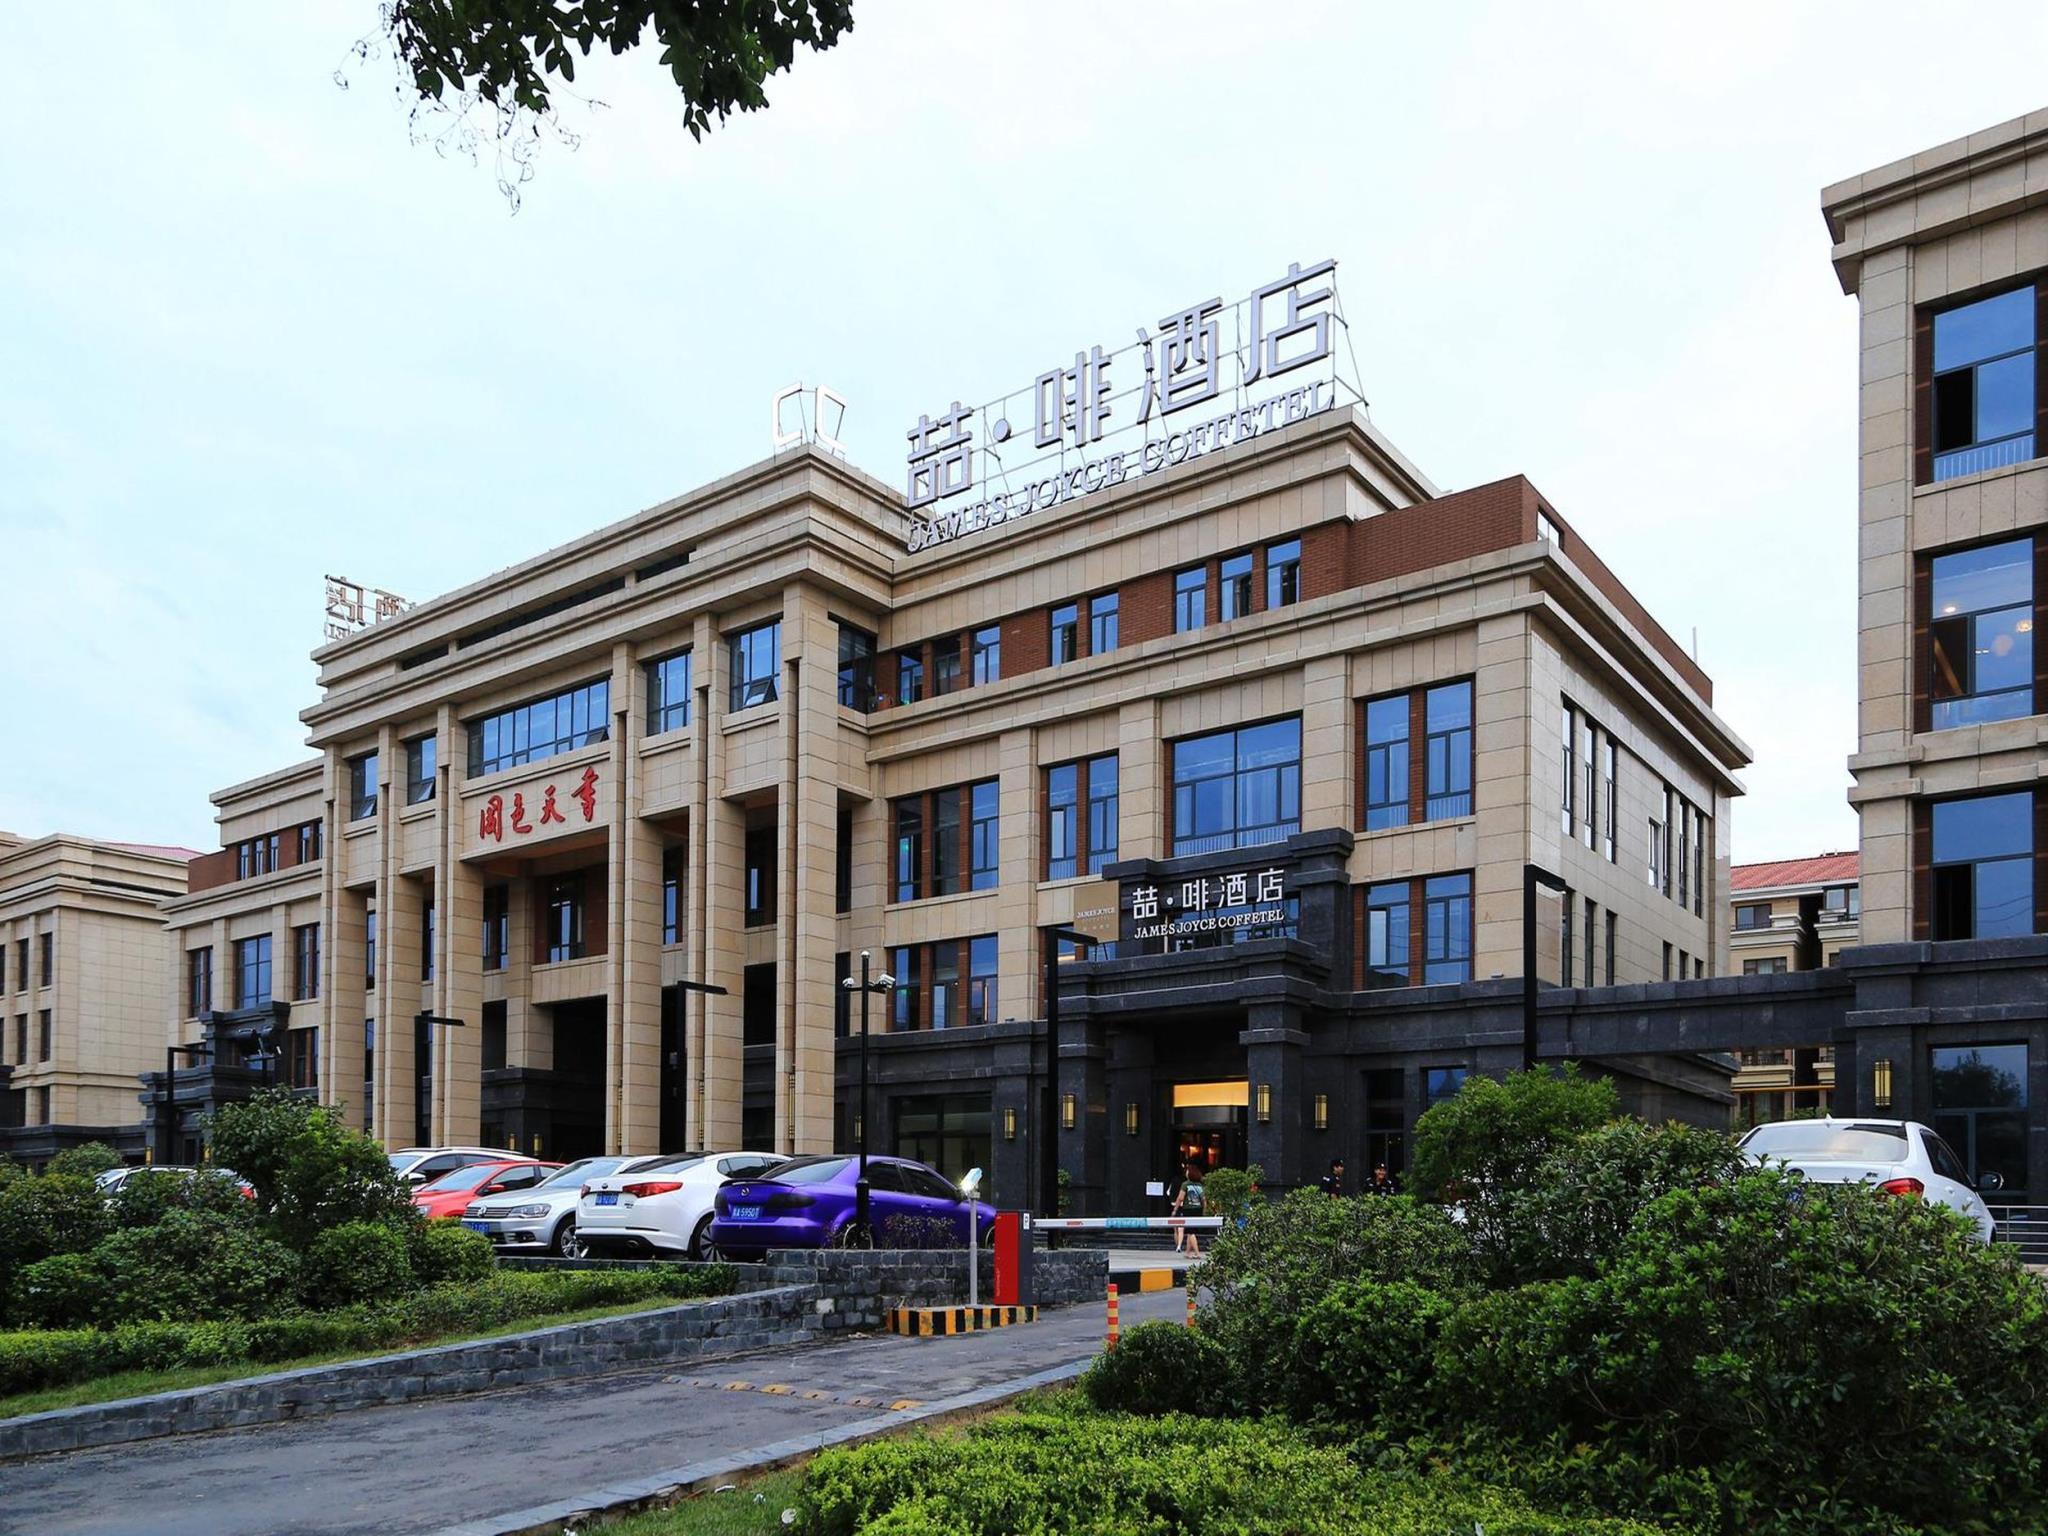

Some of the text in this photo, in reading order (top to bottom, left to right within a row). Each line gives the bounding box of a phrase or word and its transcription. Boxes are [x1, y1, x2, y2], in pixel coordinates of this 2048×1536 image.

[907, 380, 1334, 553] JAMES JOYCE COFFETEL
[1134, 909, 1285, 939] JAMES JOYCE COFFETEL
